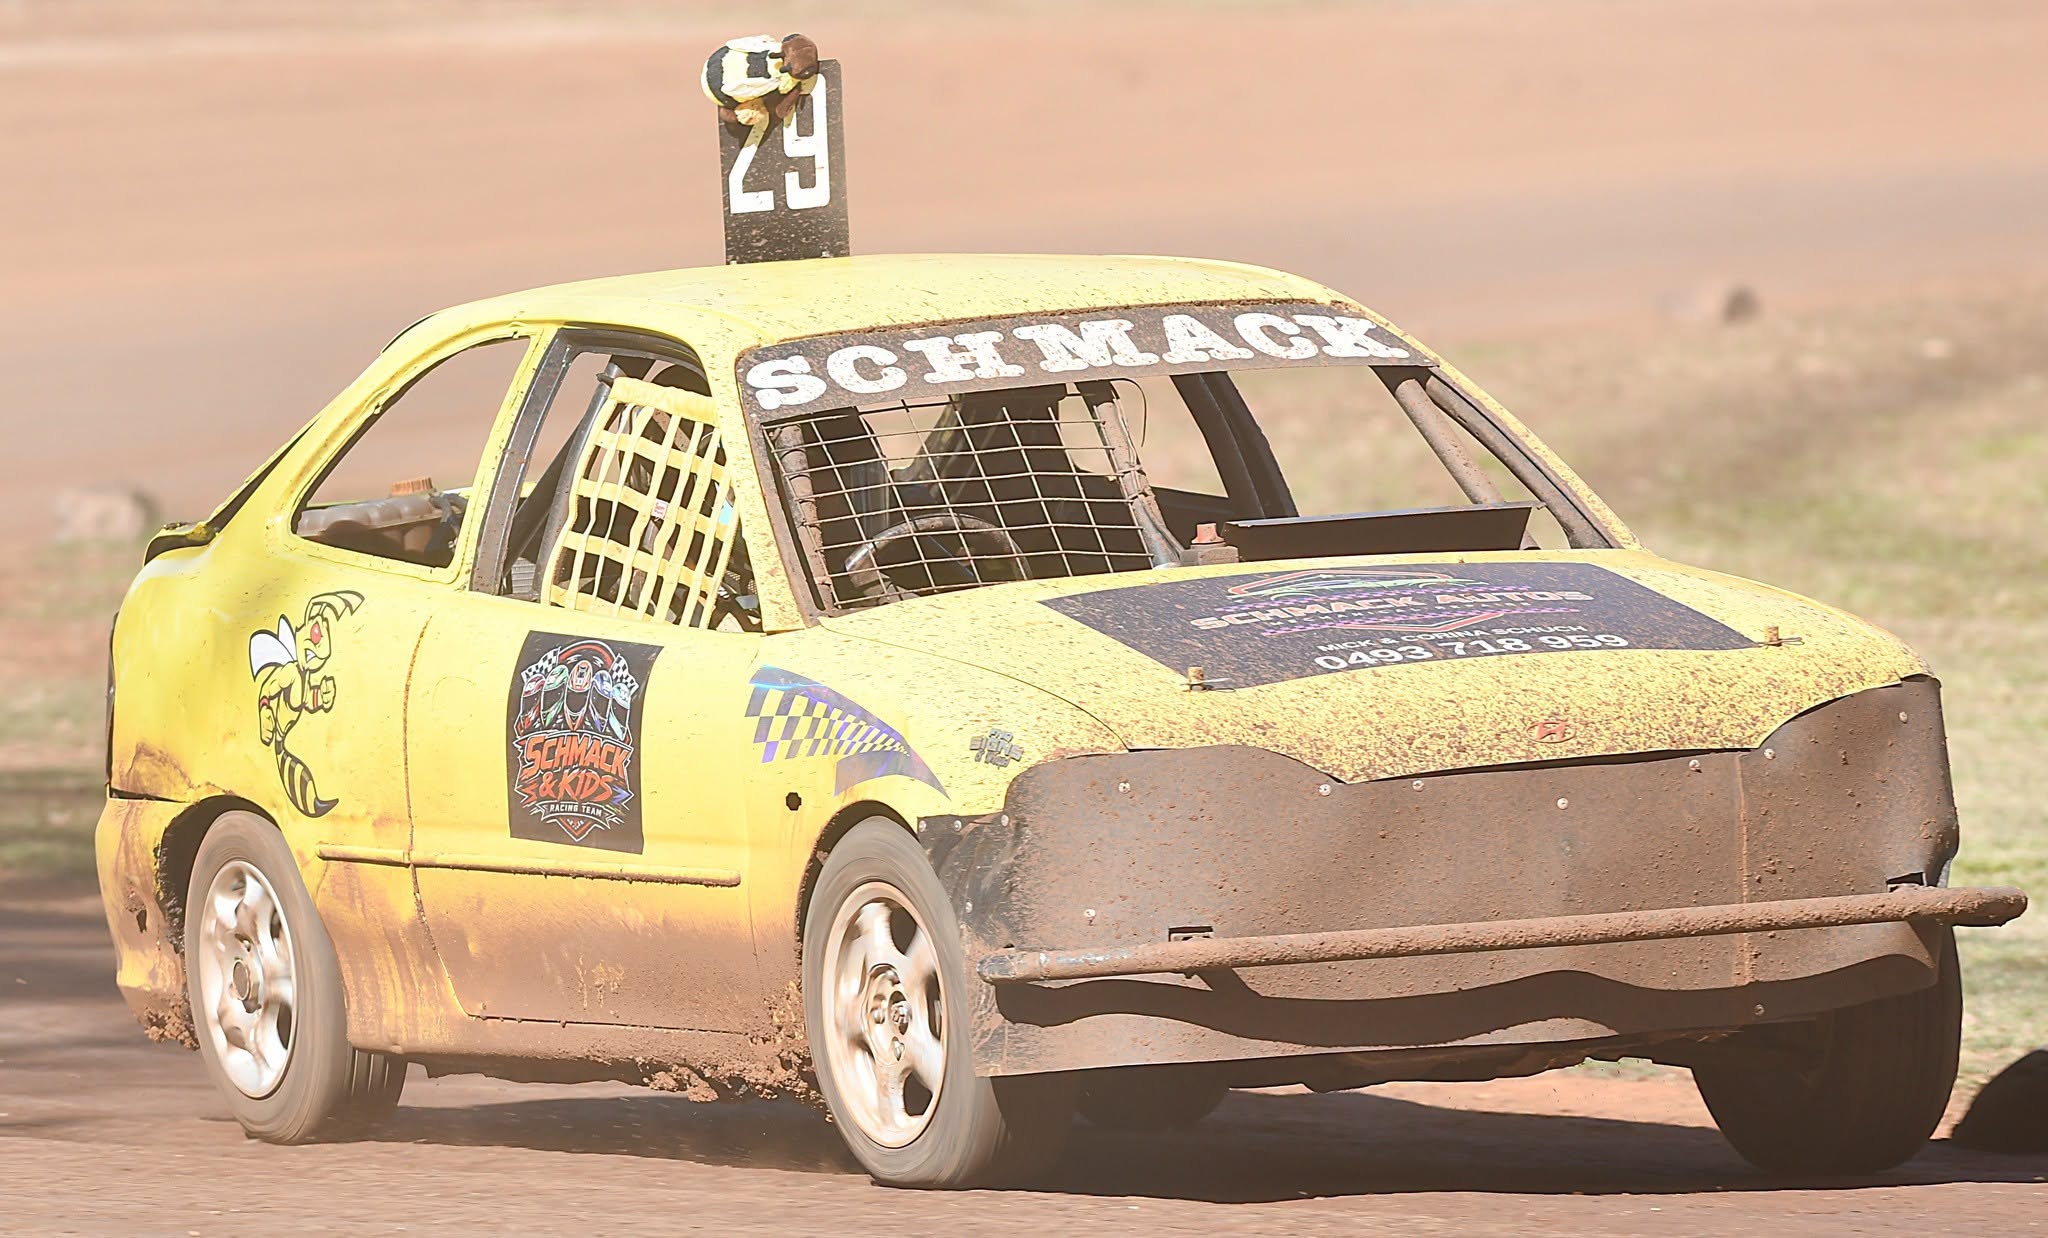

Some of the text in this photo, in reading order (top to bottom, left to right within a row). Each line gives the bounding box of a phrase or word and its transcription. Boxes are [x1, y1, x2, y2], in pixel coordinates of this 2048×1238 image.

[728, 72, 831, 214] 29
[746, 312, 1410, 410] SCHMACK
[1190, 591, 1595, 630] SCHMACK AUTOS
[1314, 633, 1630, 670] 0493 718 959
[1317, 625, 1589, 652] MICK & CORINA SCHUCH
[520, 735, 630, 781] SCHMACK
[538, 768, 615, 802] & KIDS
[549, 803, 604, 816] RACING TEAM
